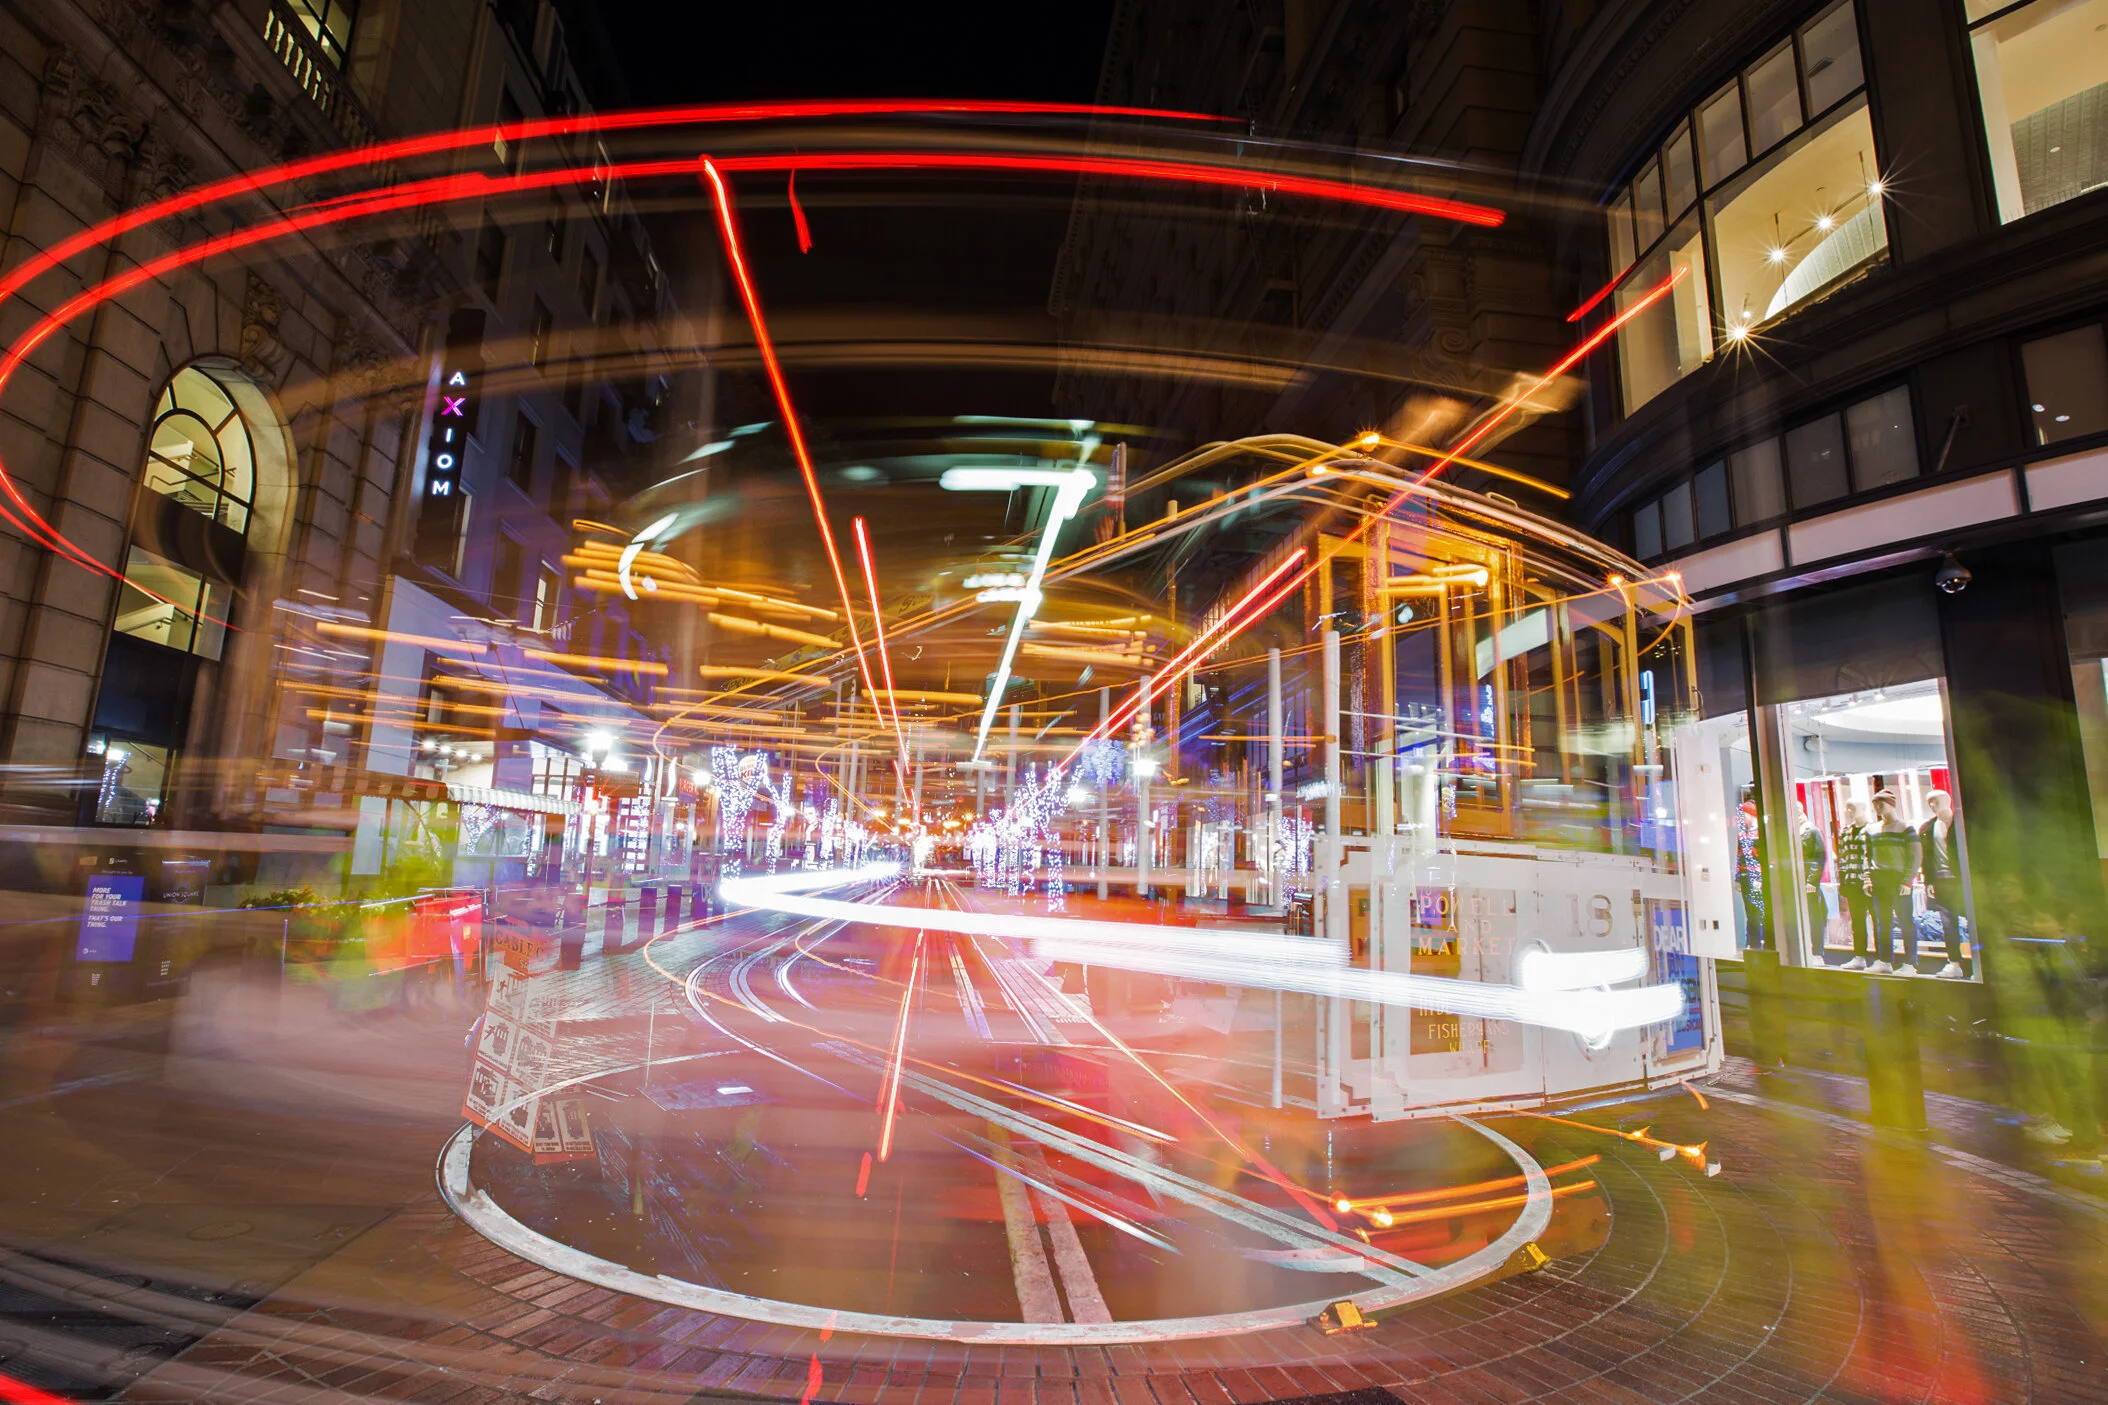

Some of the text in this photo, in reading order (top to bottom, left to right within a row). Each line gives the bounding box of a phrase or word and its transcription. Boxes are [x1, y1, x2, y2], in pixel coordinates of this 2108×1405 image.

[431, 371, 467, 496] AXIOM
[1420, 895, 1517, 917] POWELL
[1566, 894, 1613, 938] 18
[1447, 919, 1492, 933] AND
[1654, 925, 1686, 951] DEAR
[1418, 936, 1516, 956] MARKET
